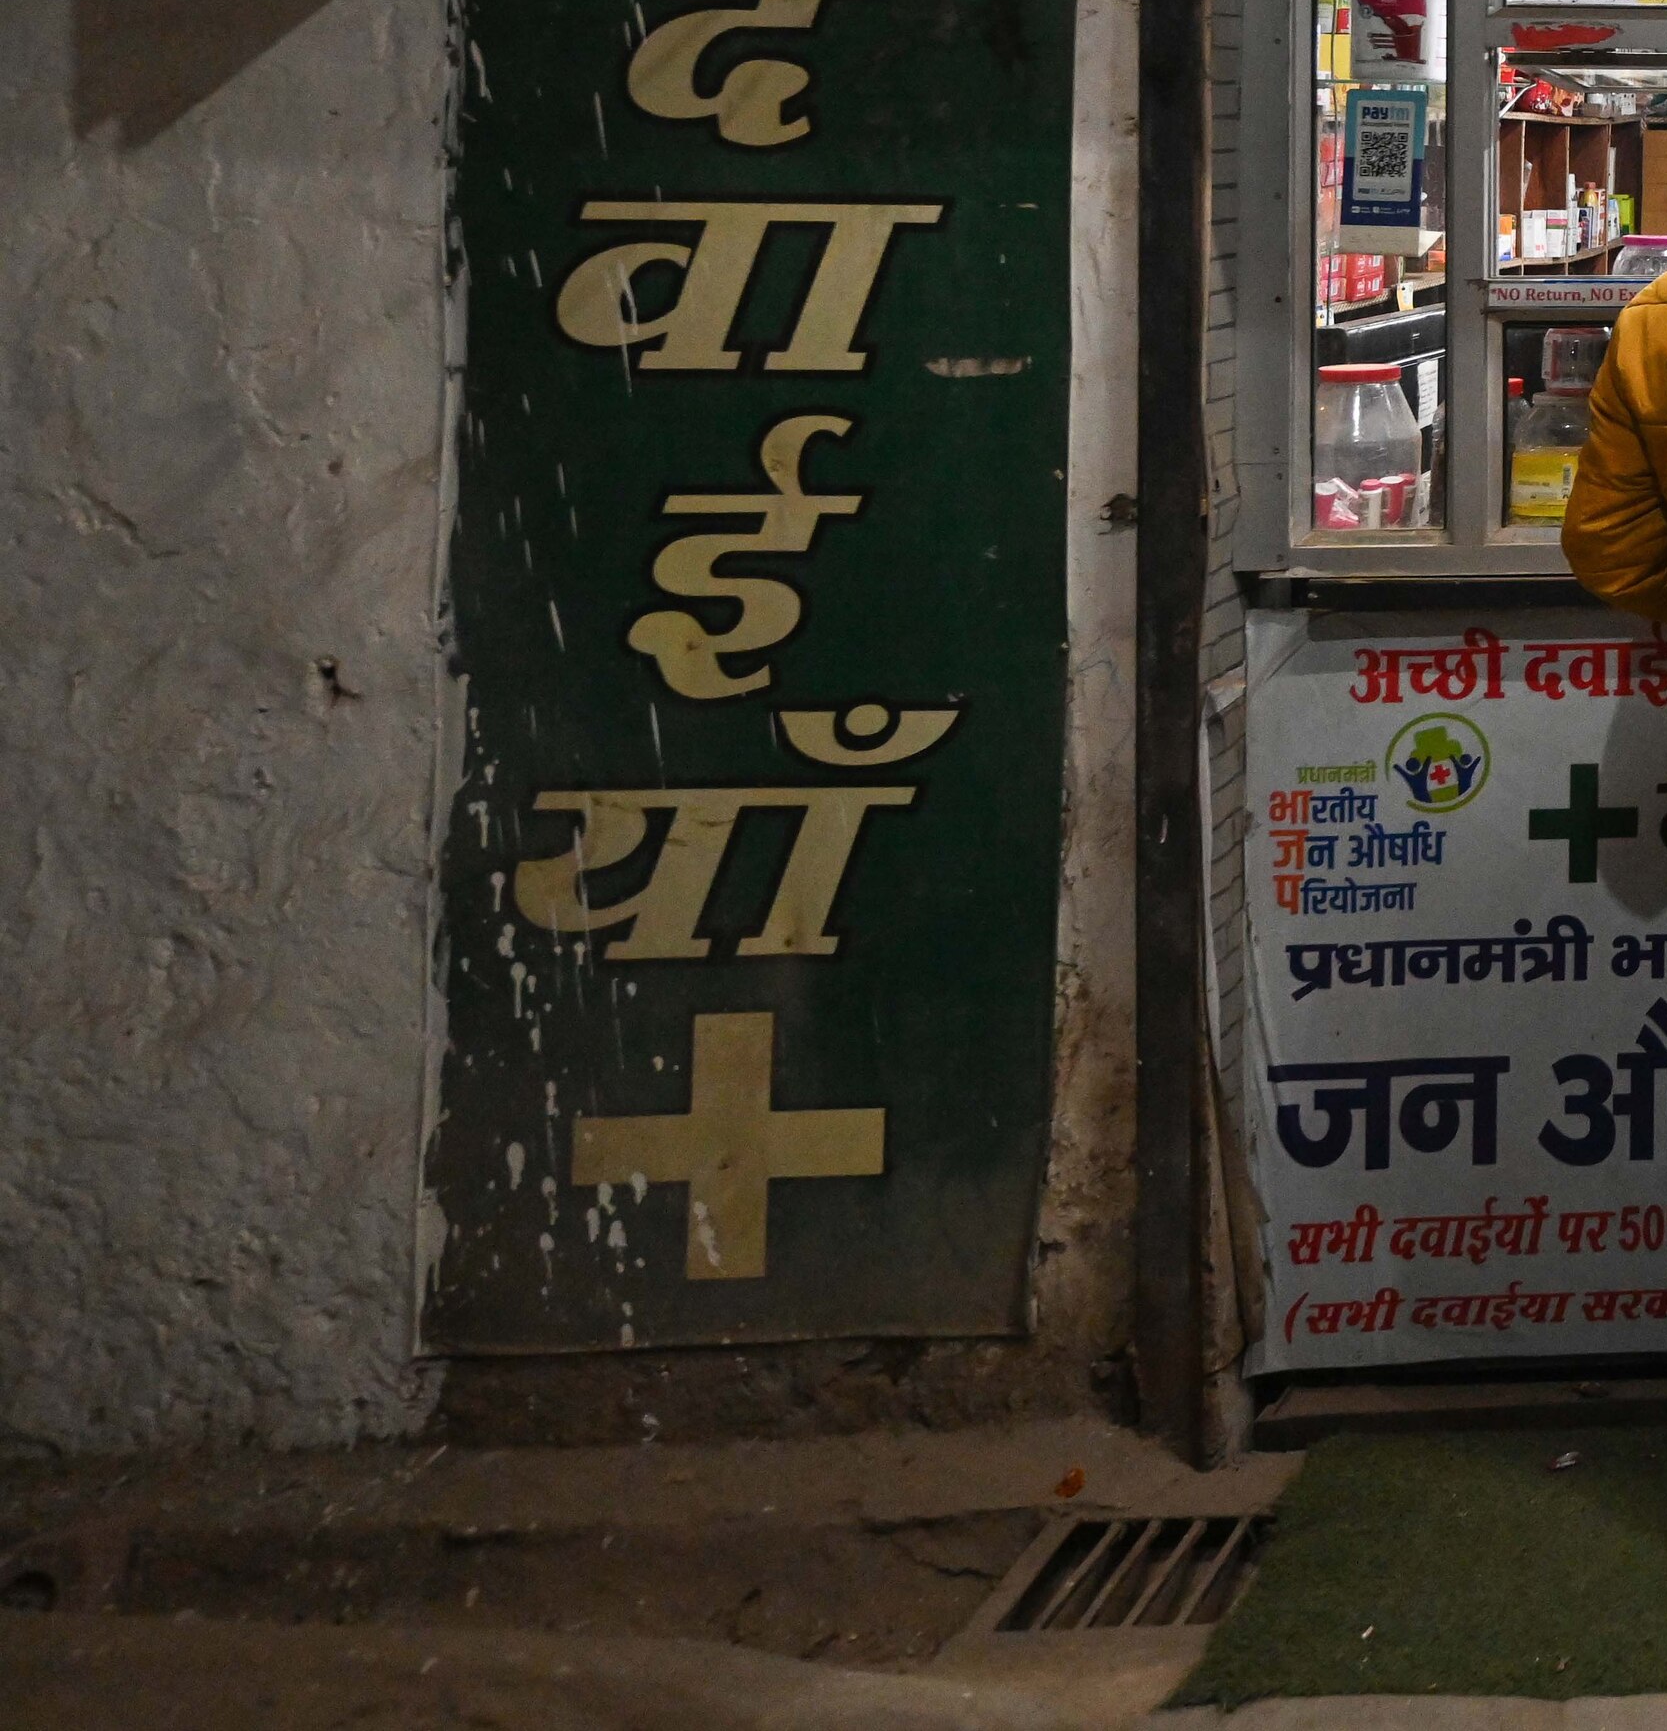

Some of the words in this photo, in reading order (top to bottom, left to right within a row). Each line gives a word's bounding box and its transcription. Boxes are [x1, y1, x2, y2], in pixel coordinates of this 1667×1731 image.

[1590, 287, 1614, 301] NO
[1350, 627, 1508, 705] अच्छी
[1269, 787, 1379, 824] भारतीय
[1269, 829, 1338, 869] जन
[1347, 822, 1447, 868] औषधि
[1273, 874, 1417, 915] परियोजना
[1286, 915, 1594, 1002] प्रधानमंत्री
[1267, 1055, 1511, 1171] जन
[1287, 1204, 1384, 1266] सभी
[1389, 1195, 1551, 1266] दवाईयों
[1558, 1210, 1617, 1255] पर
